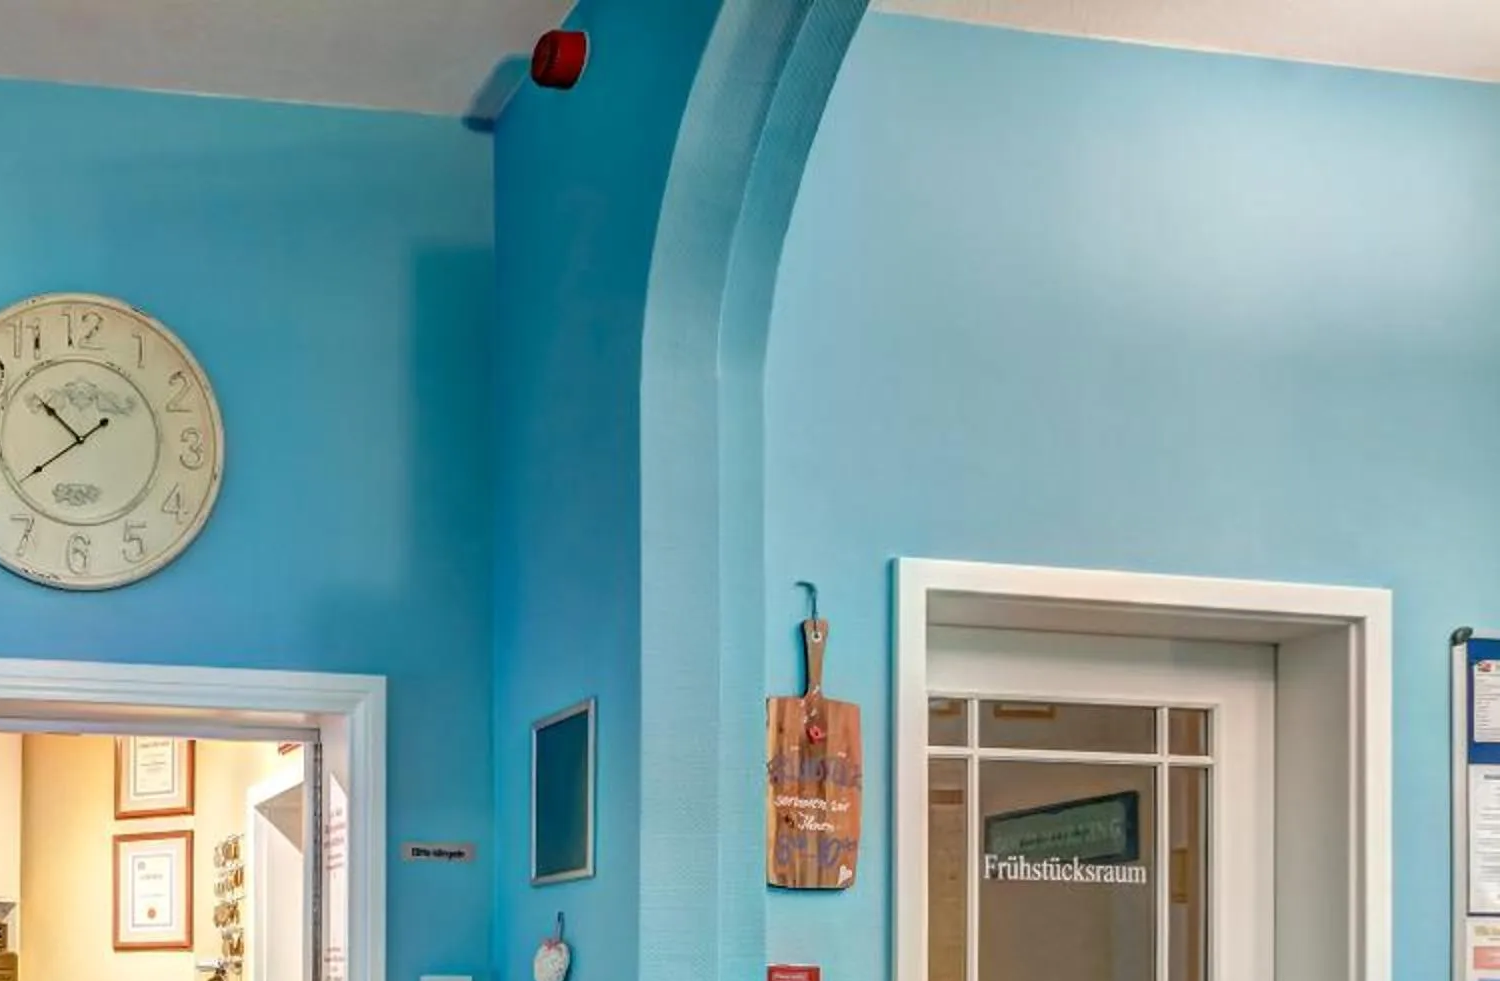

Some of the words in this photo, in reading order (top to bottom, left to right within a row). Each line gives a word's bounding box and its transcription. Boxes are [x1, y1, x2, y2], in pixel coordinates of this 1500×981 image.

[6, 318, 42, 360] 11
[62, 311, 105, 350] 12
[132, 332, 146, 369] 1
[166, 370, 192, 413] 2
[179, 426, 204, 470] 3
[161, 483, 188, 524] 4
[10, 514, 36, 557] 7
[65, 534, 91, 575] 6
[122, 522, 147, 563] 5
[984, 854, 1147, 883] Frühstücksraum
